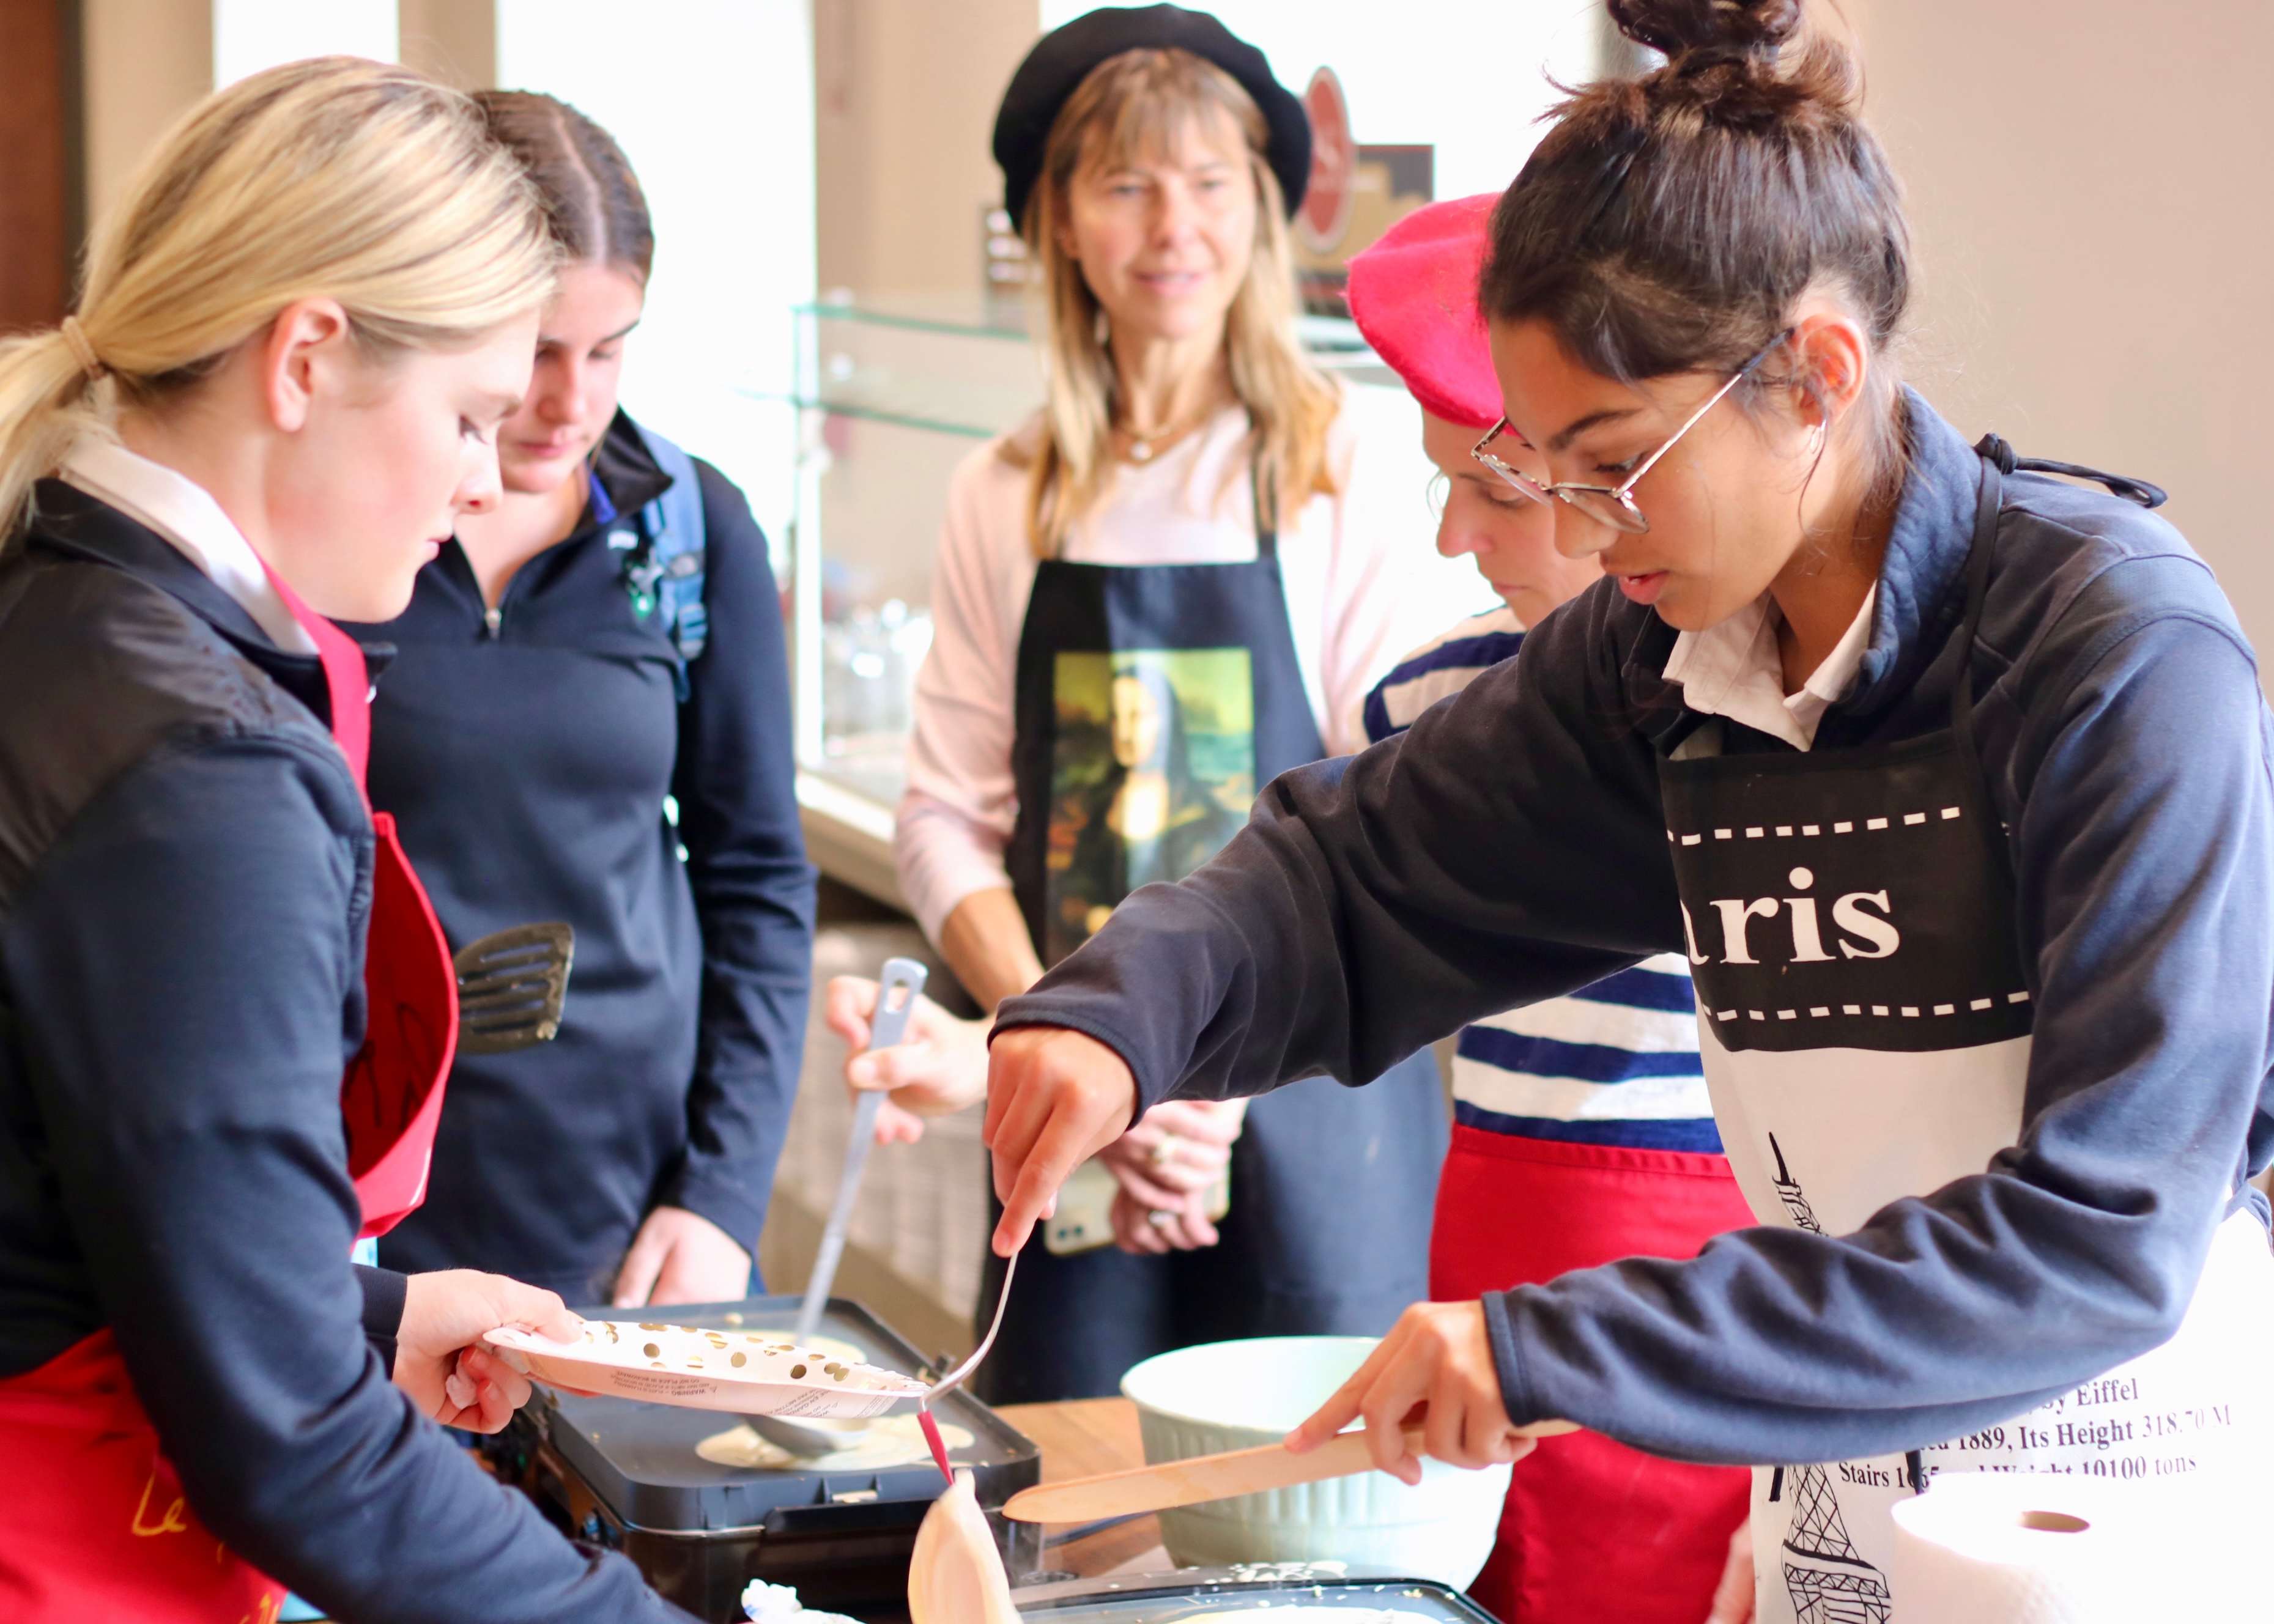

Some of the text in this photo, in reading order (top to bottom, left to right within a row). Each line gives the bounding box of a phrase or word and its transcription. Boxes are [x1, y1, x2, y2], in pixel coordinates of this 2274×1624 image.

[2077, 1378, 2139, 1406] Eiffel
[2018, 1426, 2049, 1449] Its
[2056, 1419, 2134, 1450] Height
[1839, 1461, 1890, 1487] Stairs
[2083, 1455, 2146, 1480] 10100
[2155, 1456, 2197, 1475] tons
